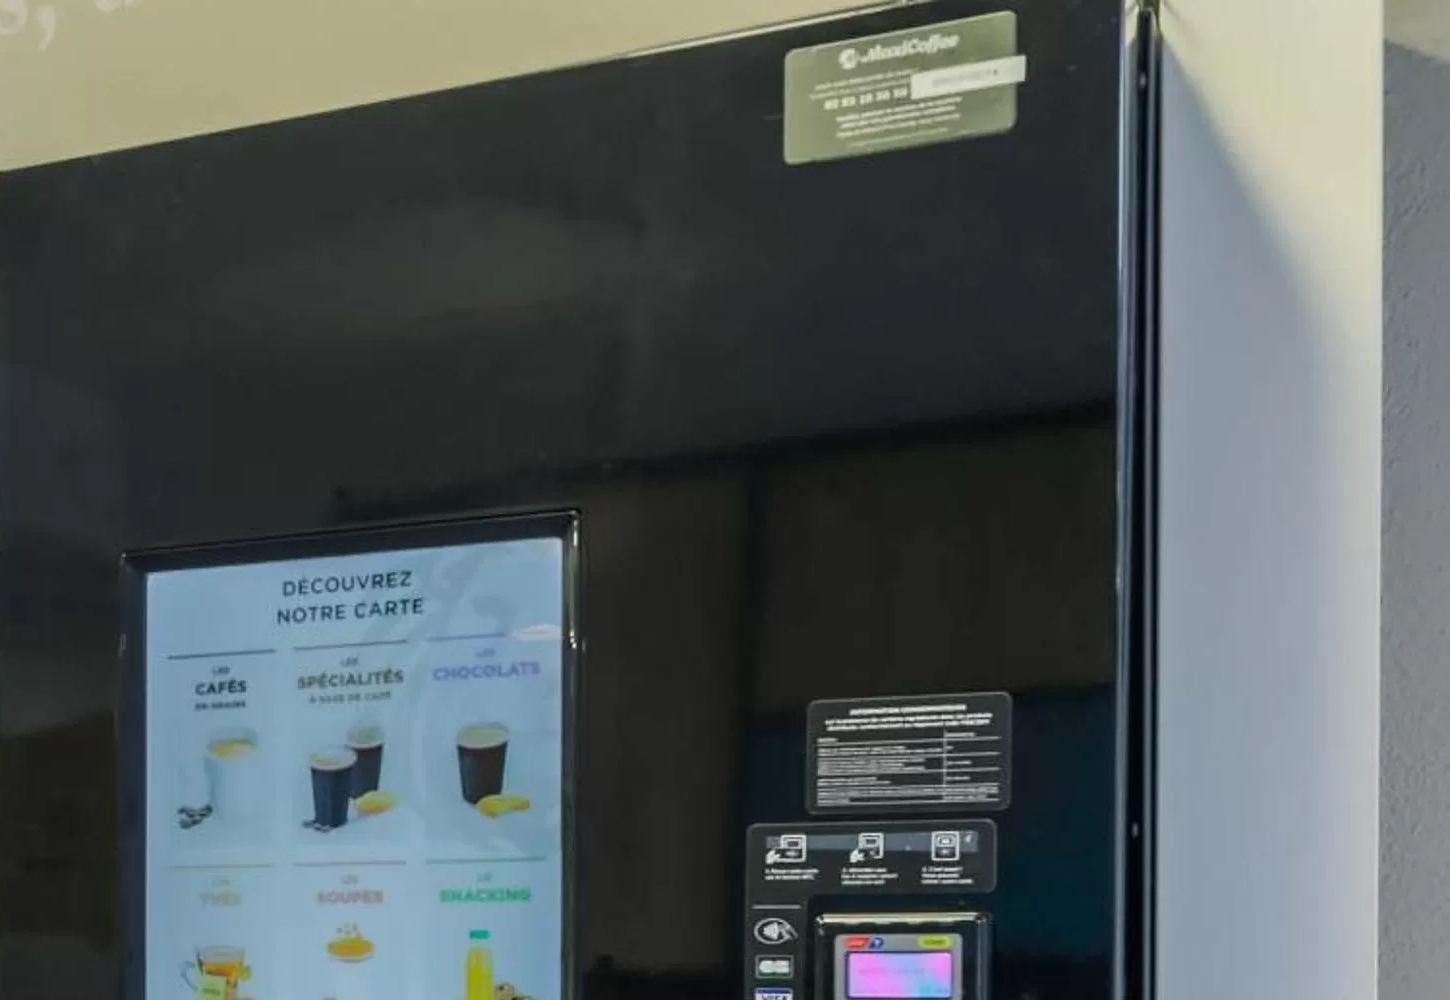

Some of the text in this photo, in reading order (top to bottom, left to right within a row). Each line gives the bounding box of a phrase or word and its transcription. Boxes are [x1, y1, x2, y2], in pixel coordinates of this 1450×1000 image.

[282, 571, 412, 598] DÉCOUVREZ
[276, 598, 424, 625] NOTRE CARTE
[298, 668, 404, 690] SPÉCIALITÉS
[433, 661, 540, 682] CHOCOLATS
[195, 679, 247, 696] CAFÉS
